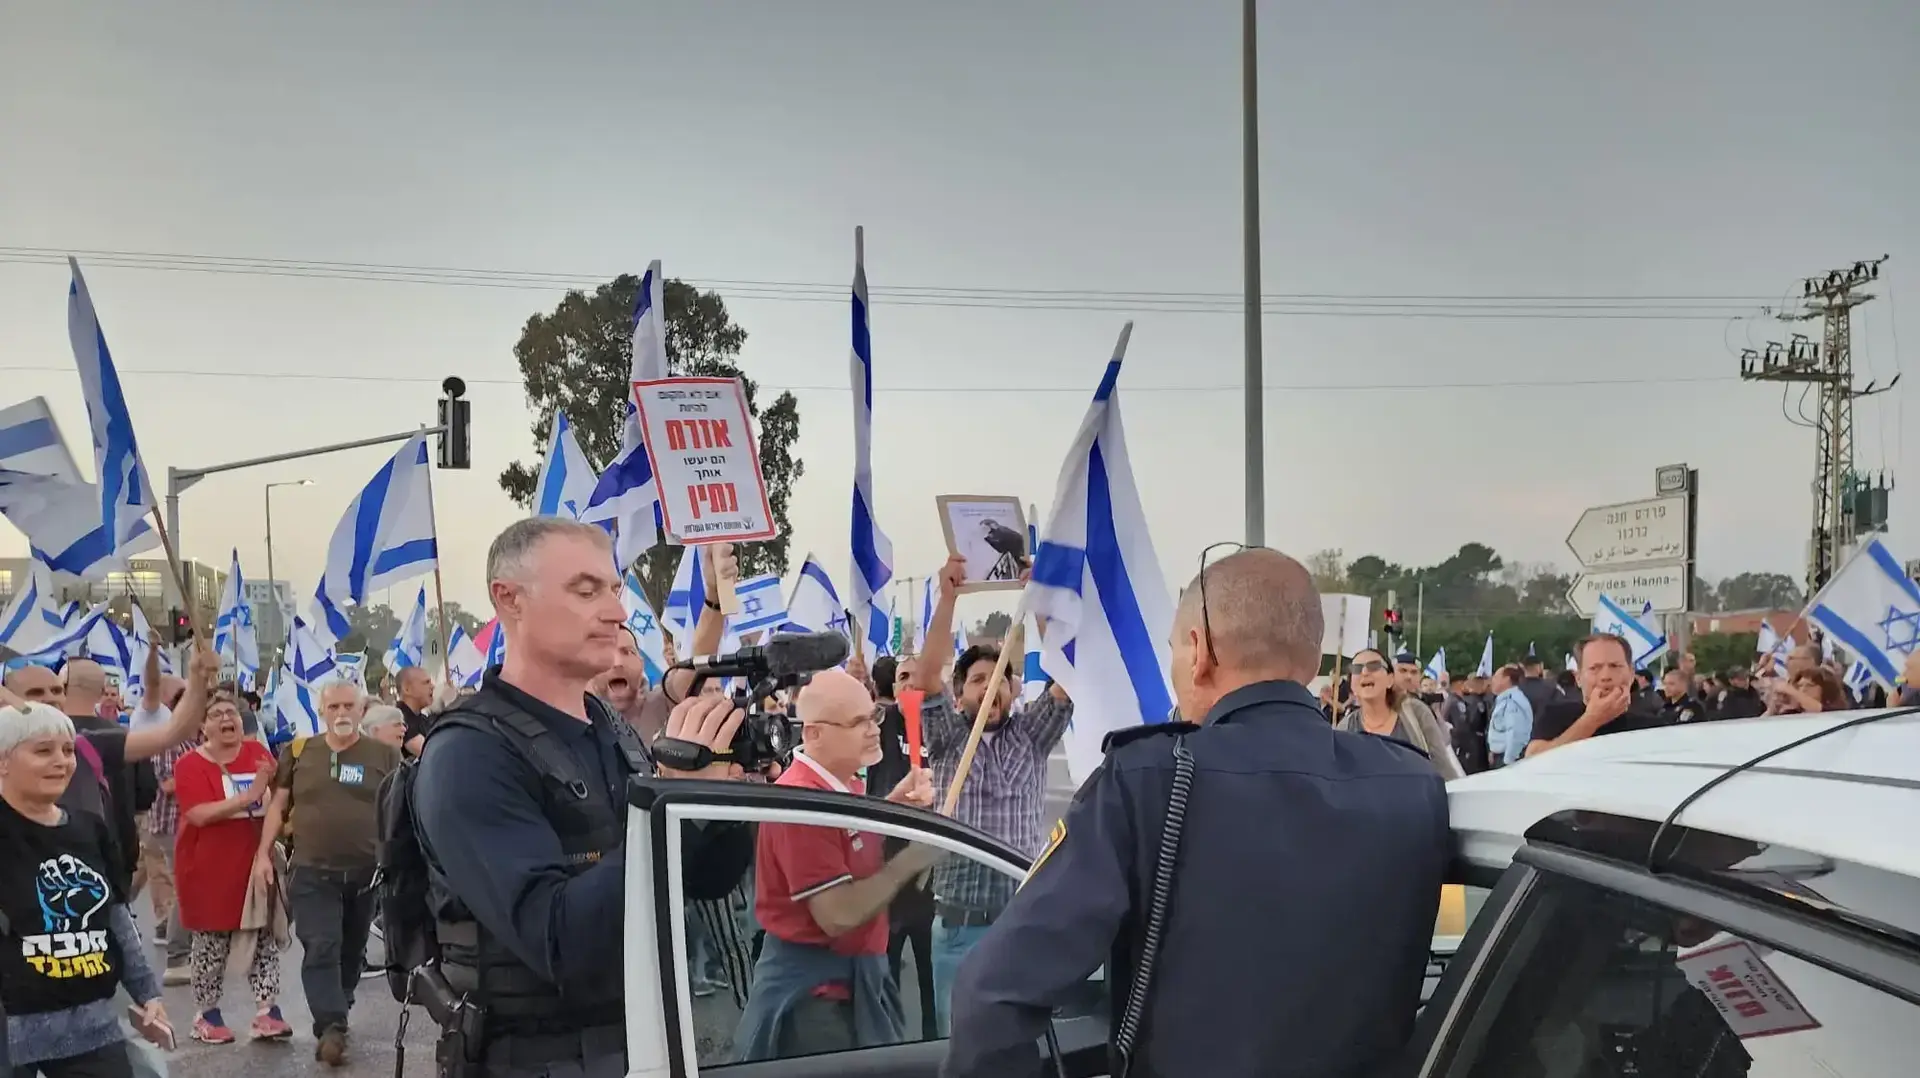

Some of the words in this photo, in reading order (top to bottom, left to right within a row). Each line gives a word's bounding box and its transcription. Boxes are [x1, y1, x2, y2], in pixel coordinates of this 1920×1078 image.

[665, 419, 733, 451] אזרח
[683, 456, 707, 465] יעשו
[710, 455, 726, 465] הם
[694, 469, 722, 481] אותך
[1587, 579, 1627, 592] Pardes
[22, 929, 109, 959] חובה
